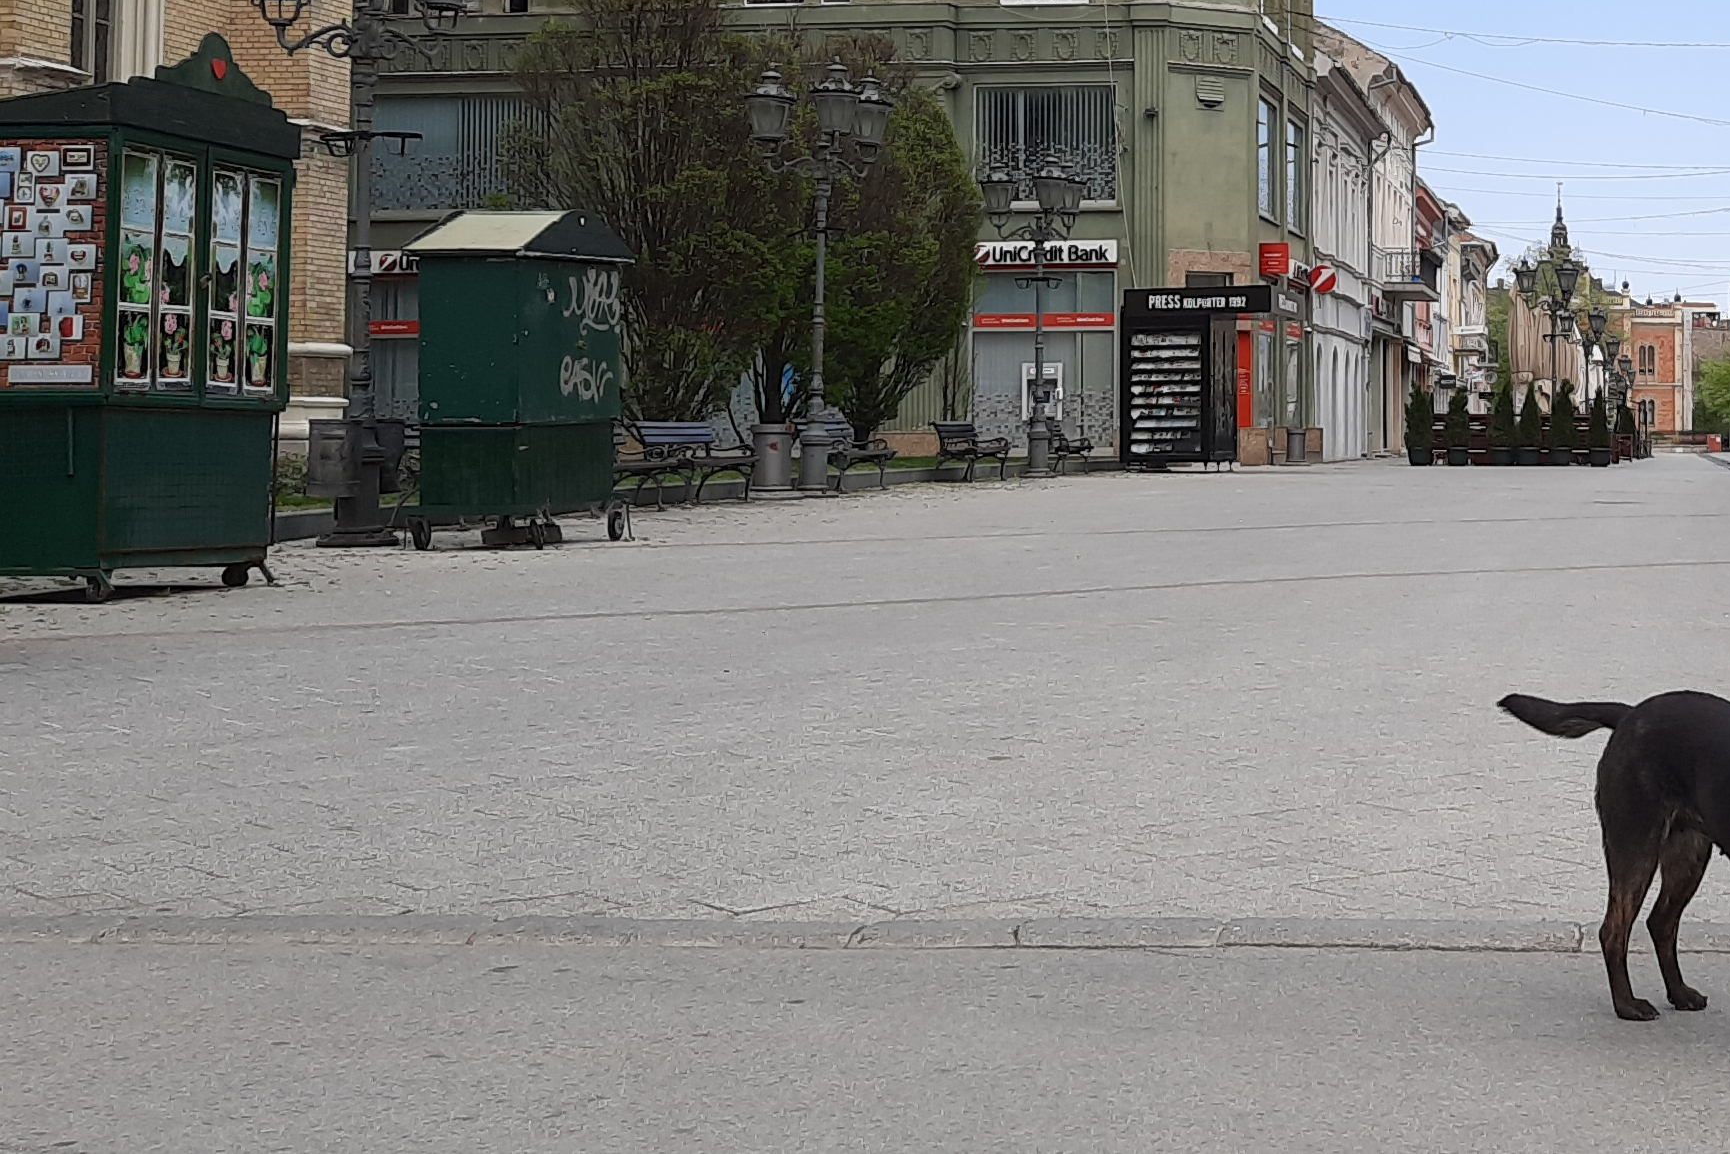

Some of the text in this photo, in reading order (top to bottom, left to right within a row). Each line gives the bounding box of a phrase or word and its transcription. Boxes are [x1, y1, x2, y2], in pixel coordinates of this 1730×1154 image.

[992, 245, 1109, 263] UniCrdit Bank
[1148, 294, 1181, 309] PRESS
